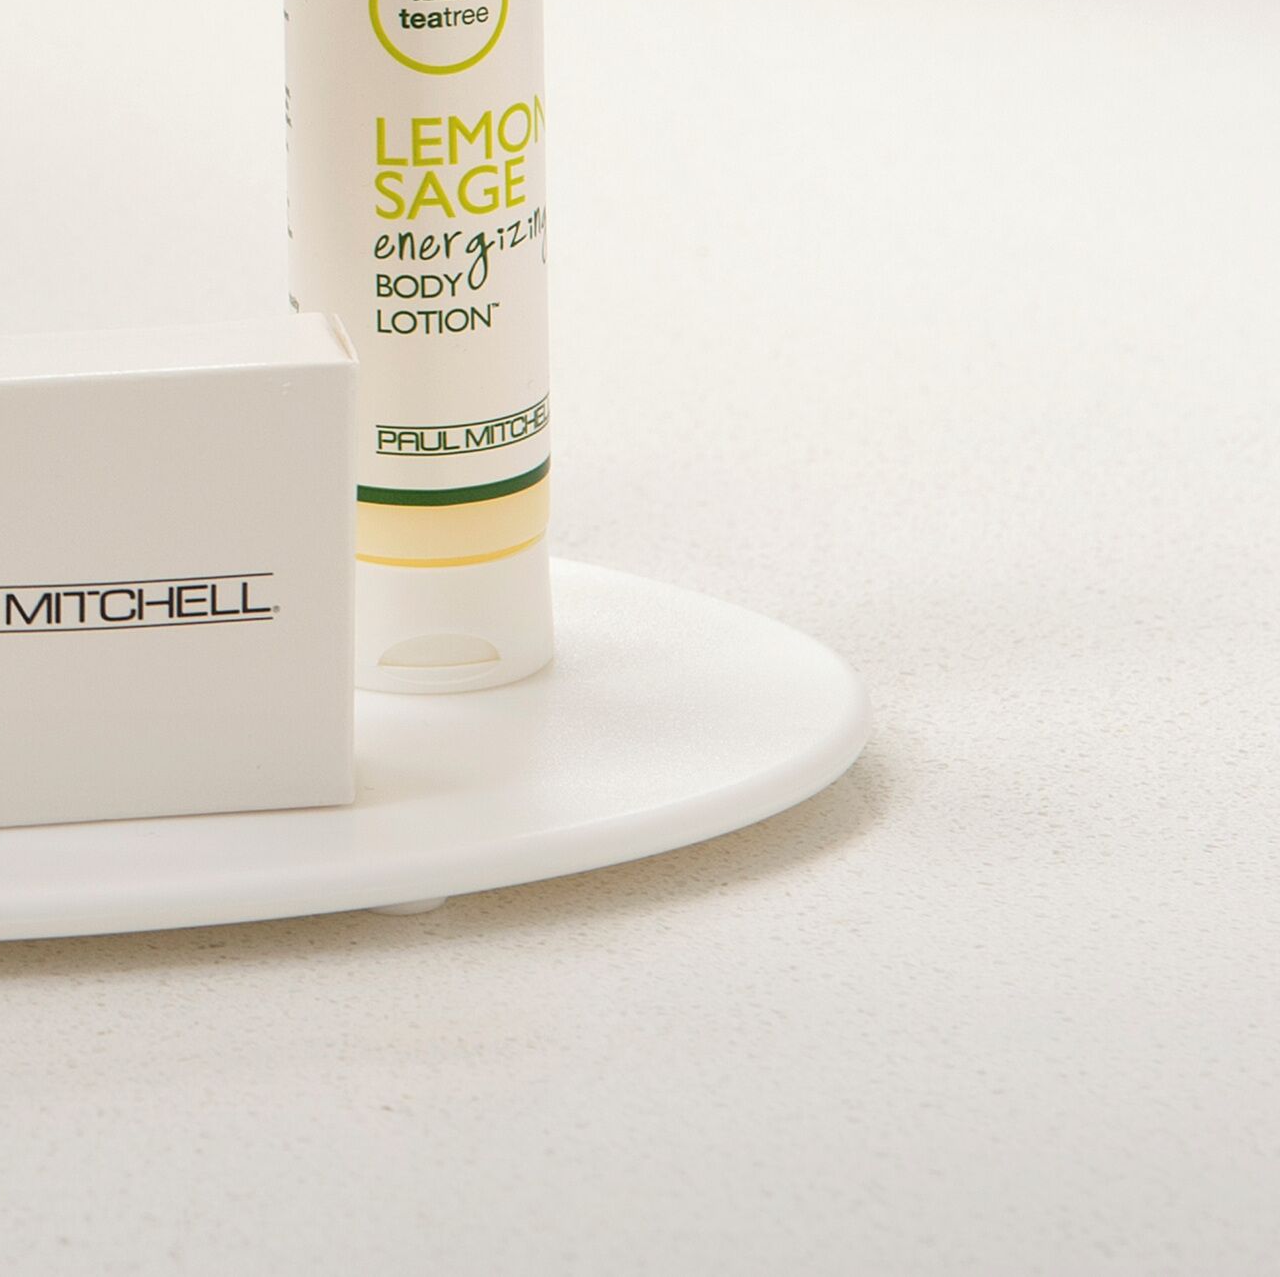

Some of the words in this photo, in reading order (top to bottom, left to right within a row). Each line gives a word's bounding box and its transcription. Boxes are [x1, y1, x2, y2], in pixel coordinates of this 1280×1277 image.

[398, 7, 488, 29] teatree
[374, 154, 526, 220] SAGE
[376, 273, 463, 299] BODY
[377, 430, 460, 451] PAUL
[5, 581, 271, 625] MITCHELL
